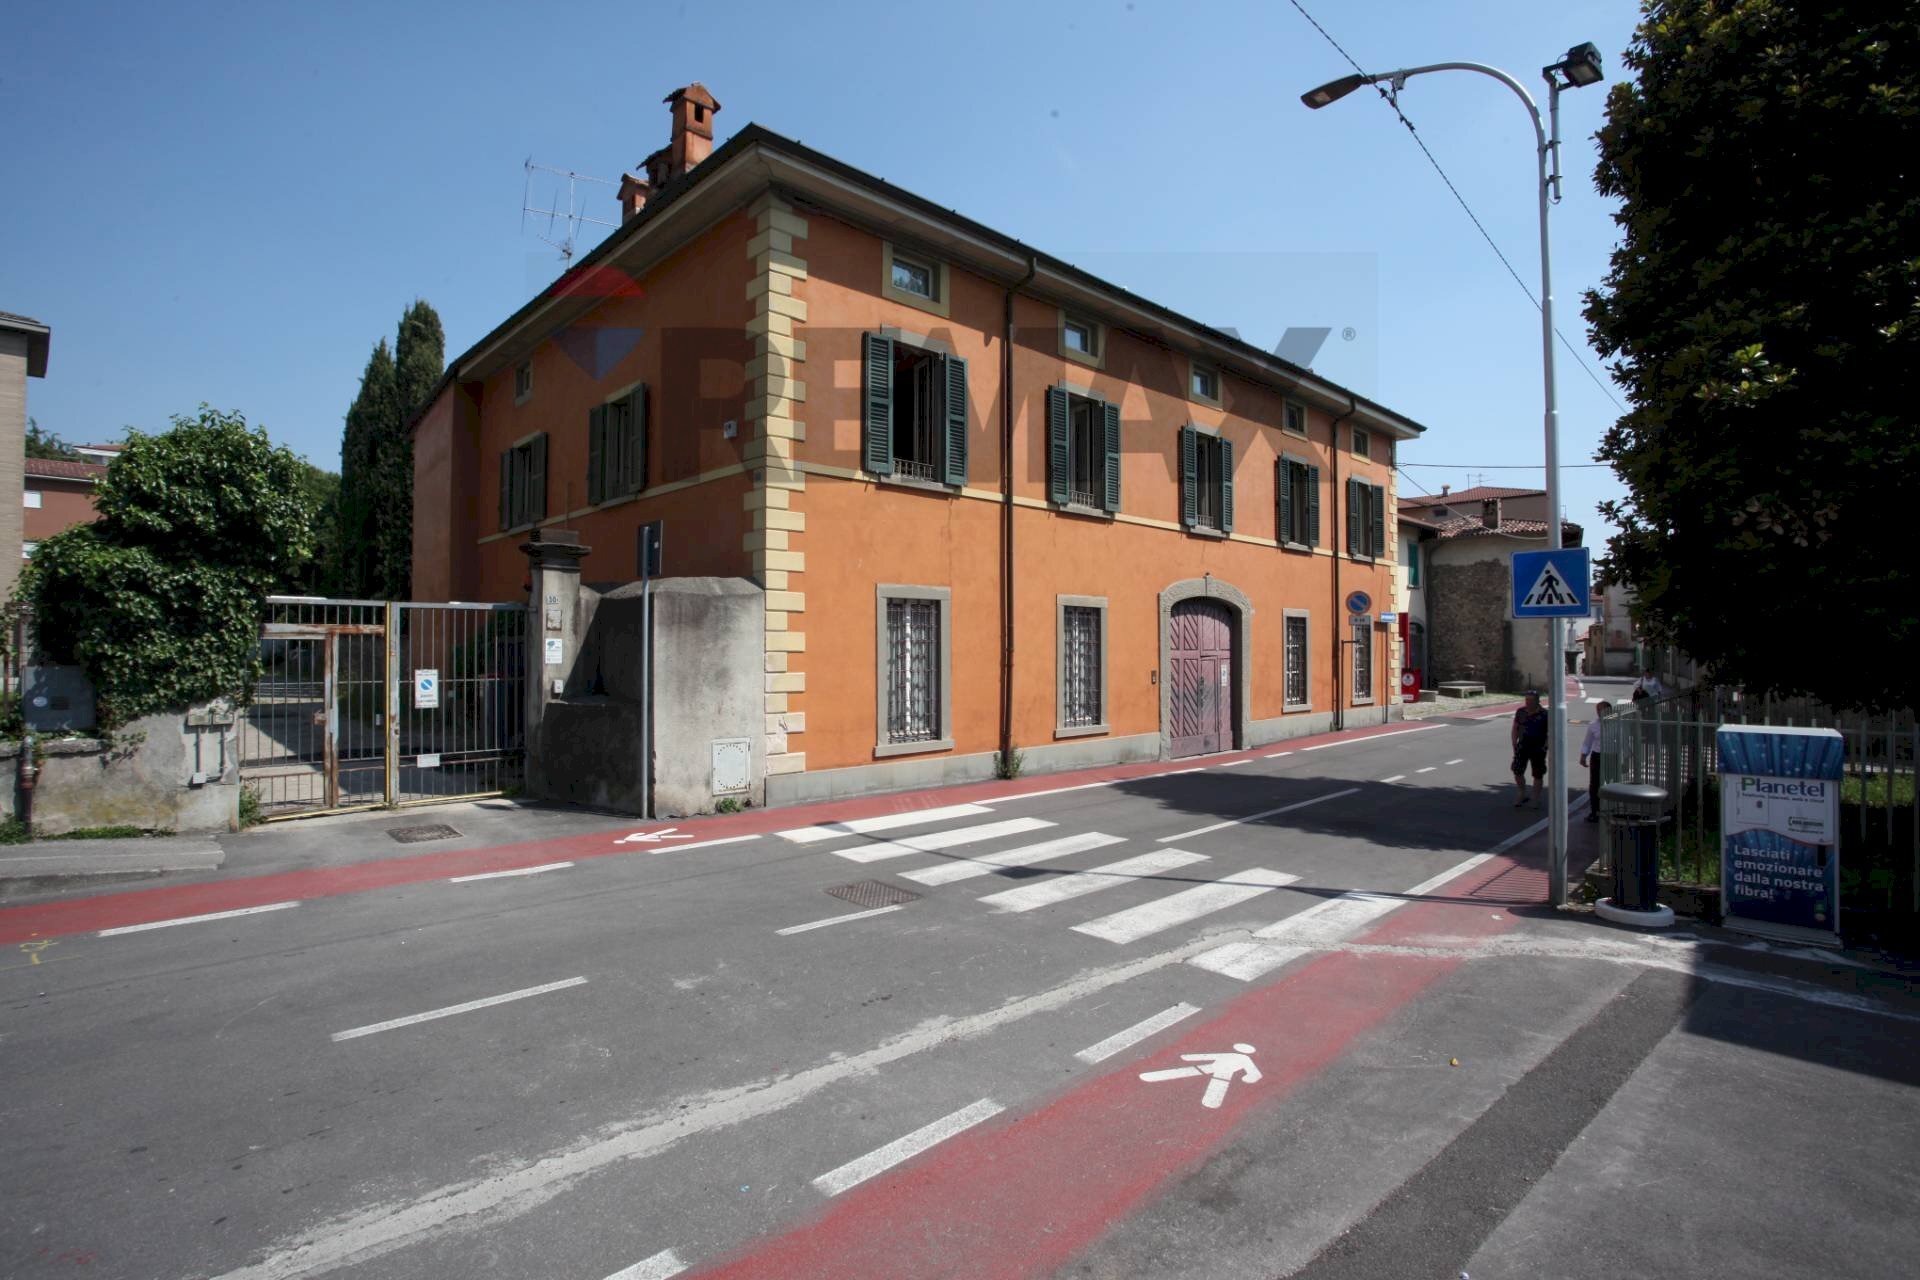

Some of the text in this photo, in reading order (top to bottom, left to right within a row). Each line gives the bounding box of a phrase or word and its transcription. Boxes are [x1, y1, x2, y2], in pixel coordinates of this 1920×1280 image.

[1741, 776, 1825, 797] Planetel
[1734, 844, 1790, 860] Lasciati
[1734, 859, 1824, 878] emozionare
[1734, 871, 1825, 892] dalla nostra
[1734, 884, 1774, 900] fibra!
